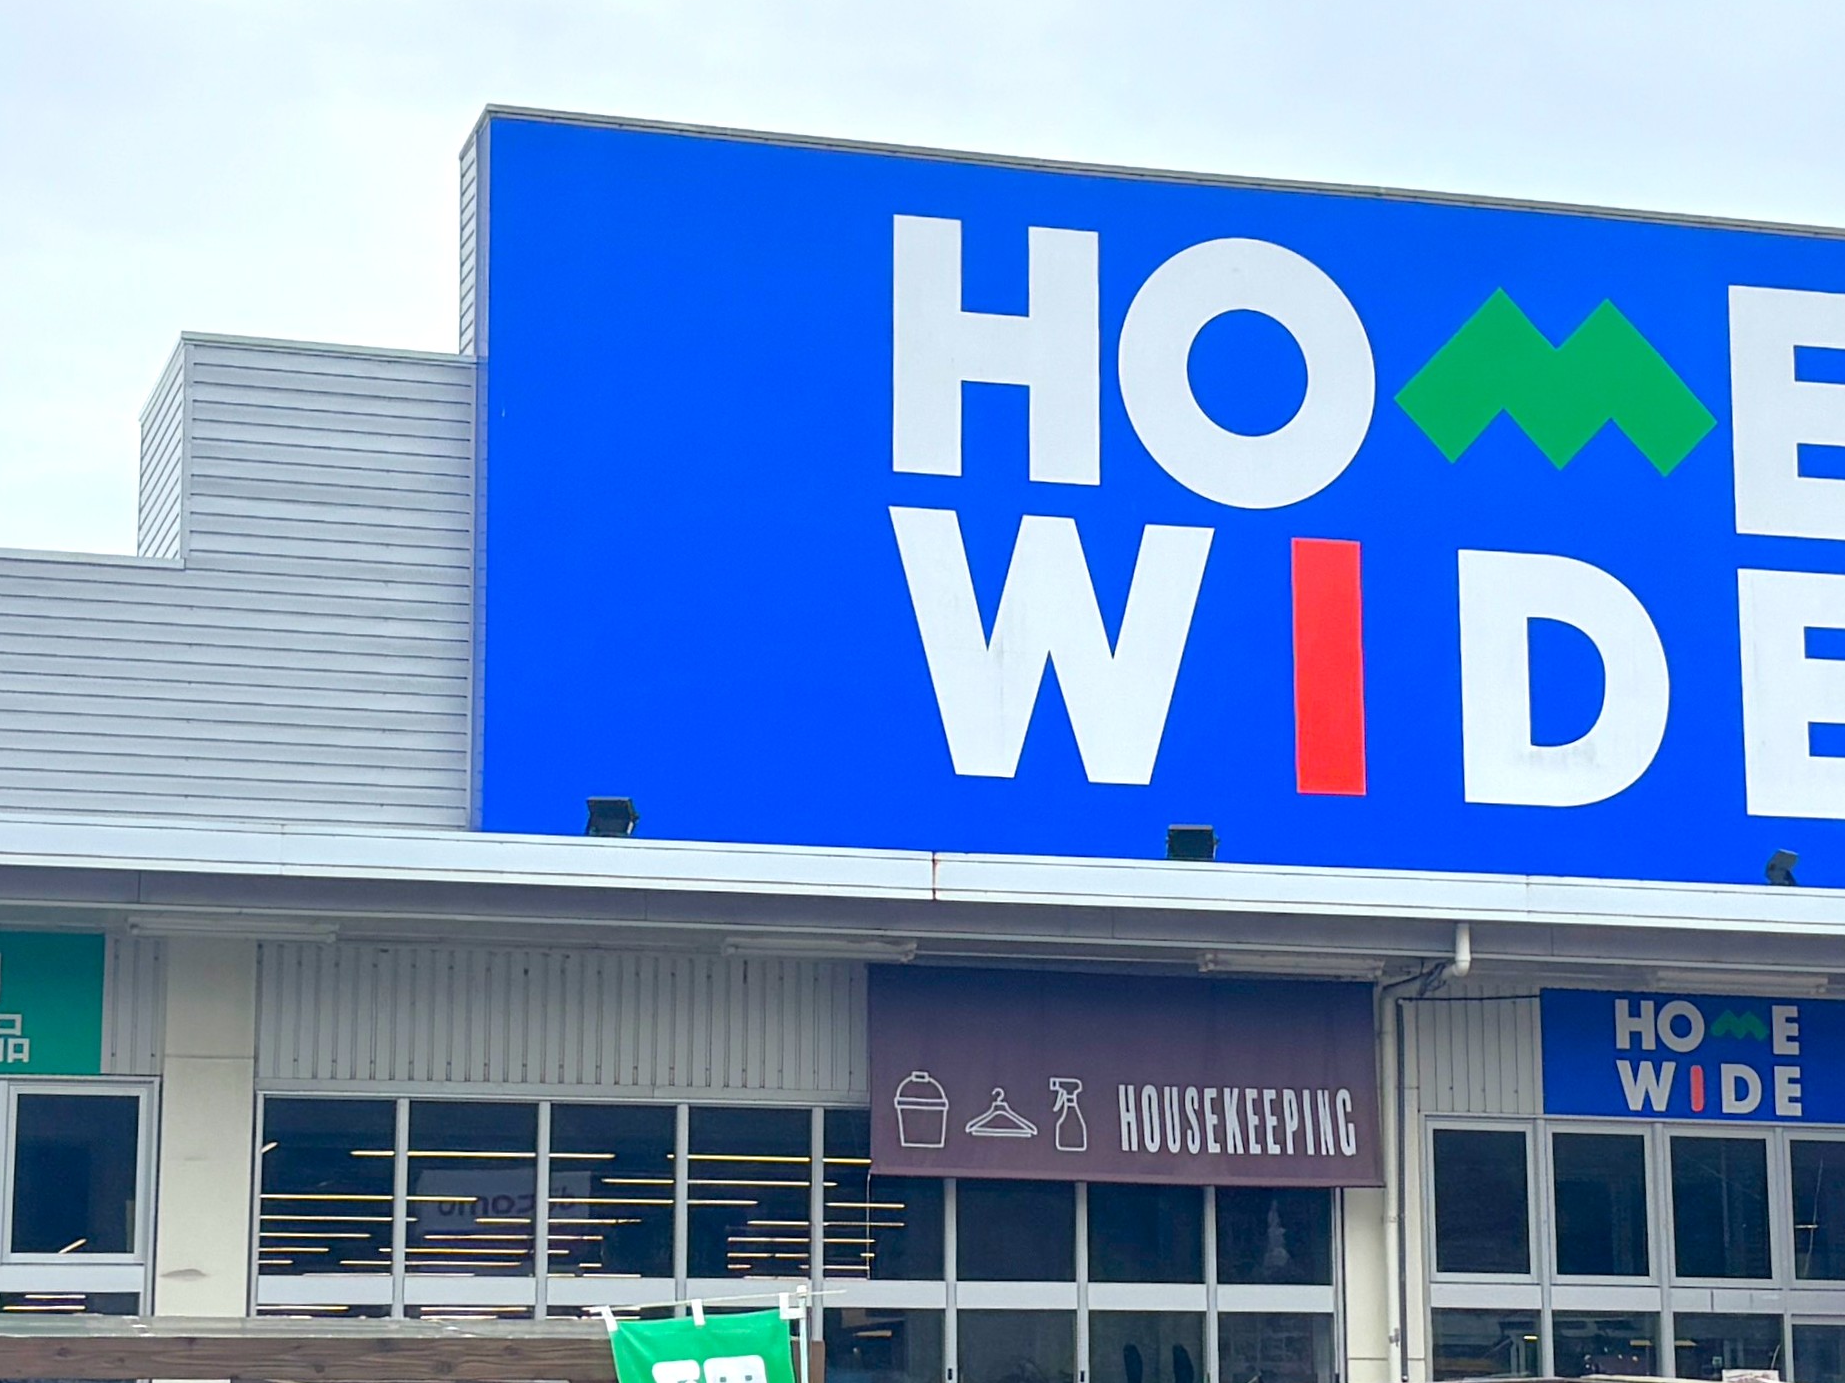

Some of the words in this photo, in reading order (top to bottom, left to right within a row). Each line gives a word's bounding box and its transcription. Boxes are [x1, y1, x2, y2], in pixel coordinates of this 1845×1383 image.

[1615, 999, 1801, 1056] HOME
[1616, 1059, 1804, 1117] WIDE
[1117, 1084, 1357, 1158] HOUSEKEEPING
